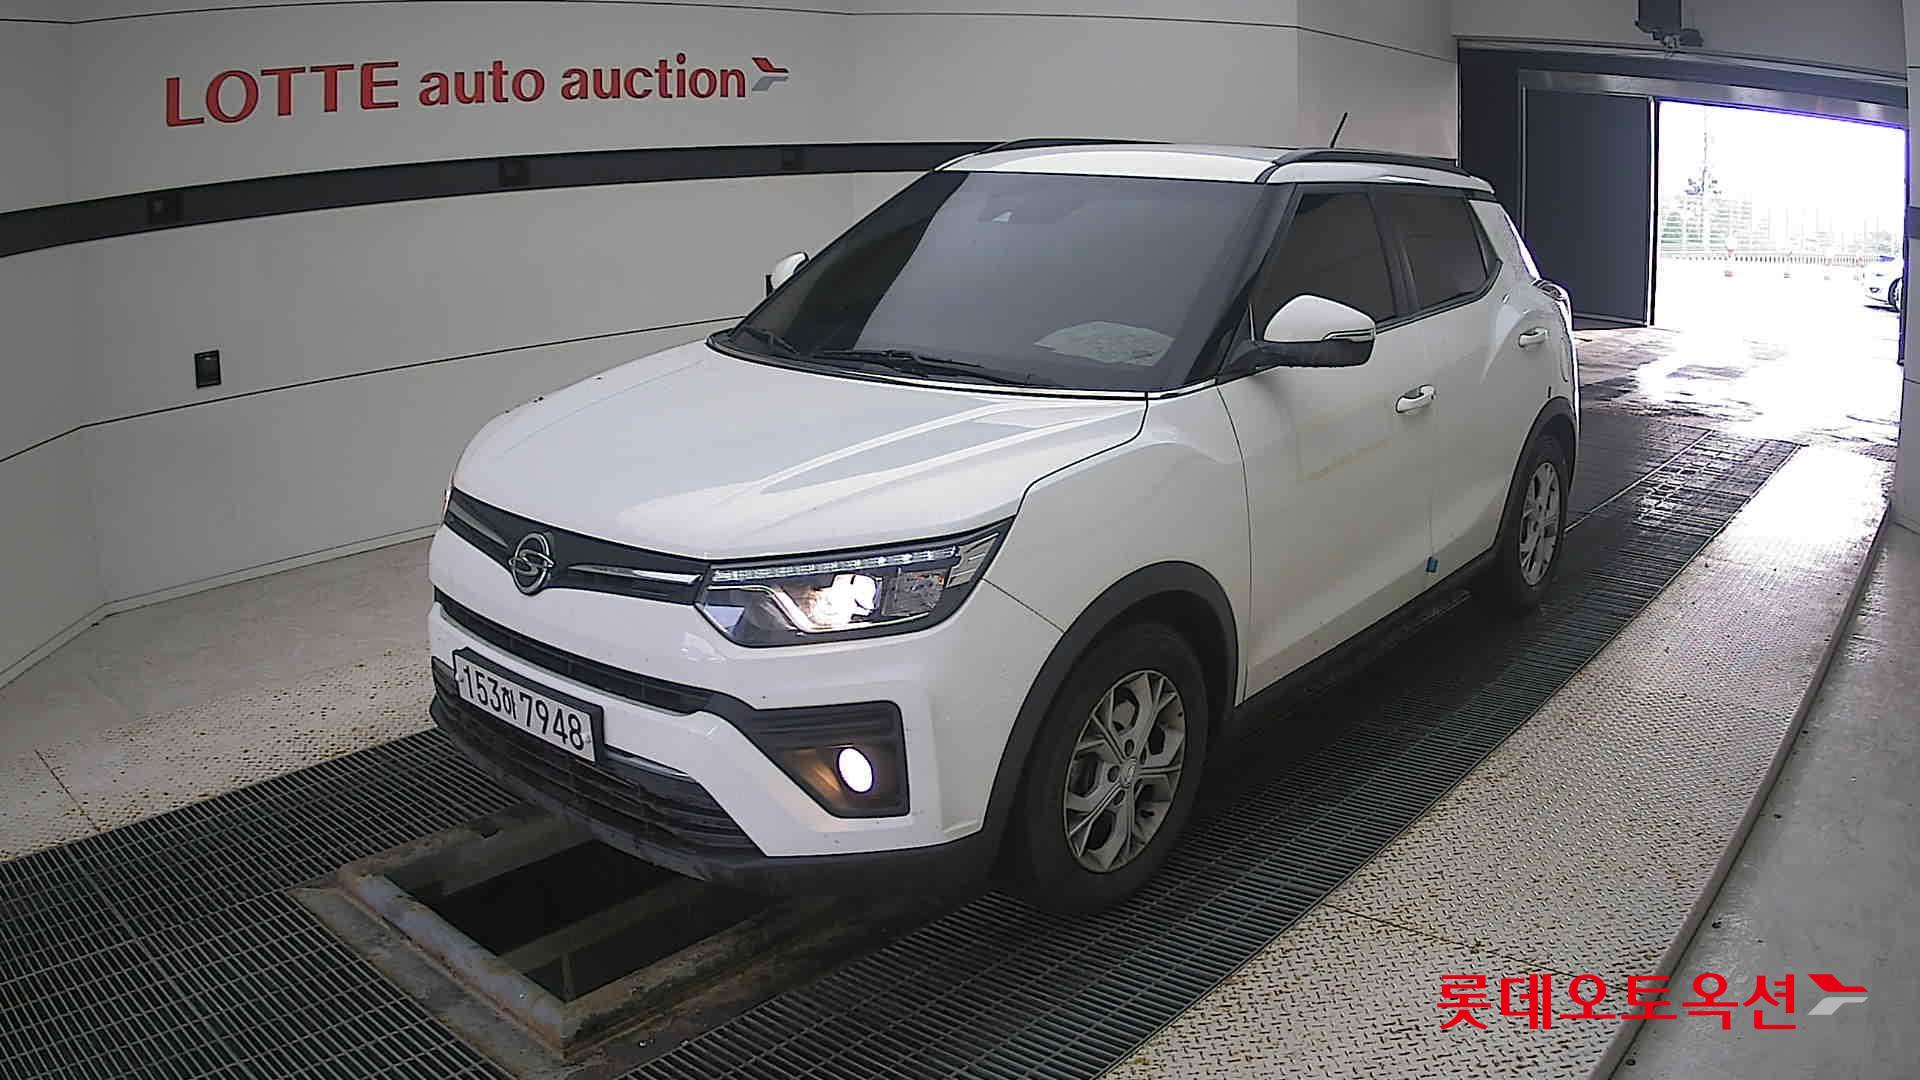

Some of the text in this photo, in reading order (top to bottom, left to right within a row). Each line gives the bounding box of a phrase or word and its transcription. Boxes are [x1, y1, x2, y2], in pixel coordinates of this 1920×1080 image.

[165, 53, 747, 127] LOTTE auto auction
